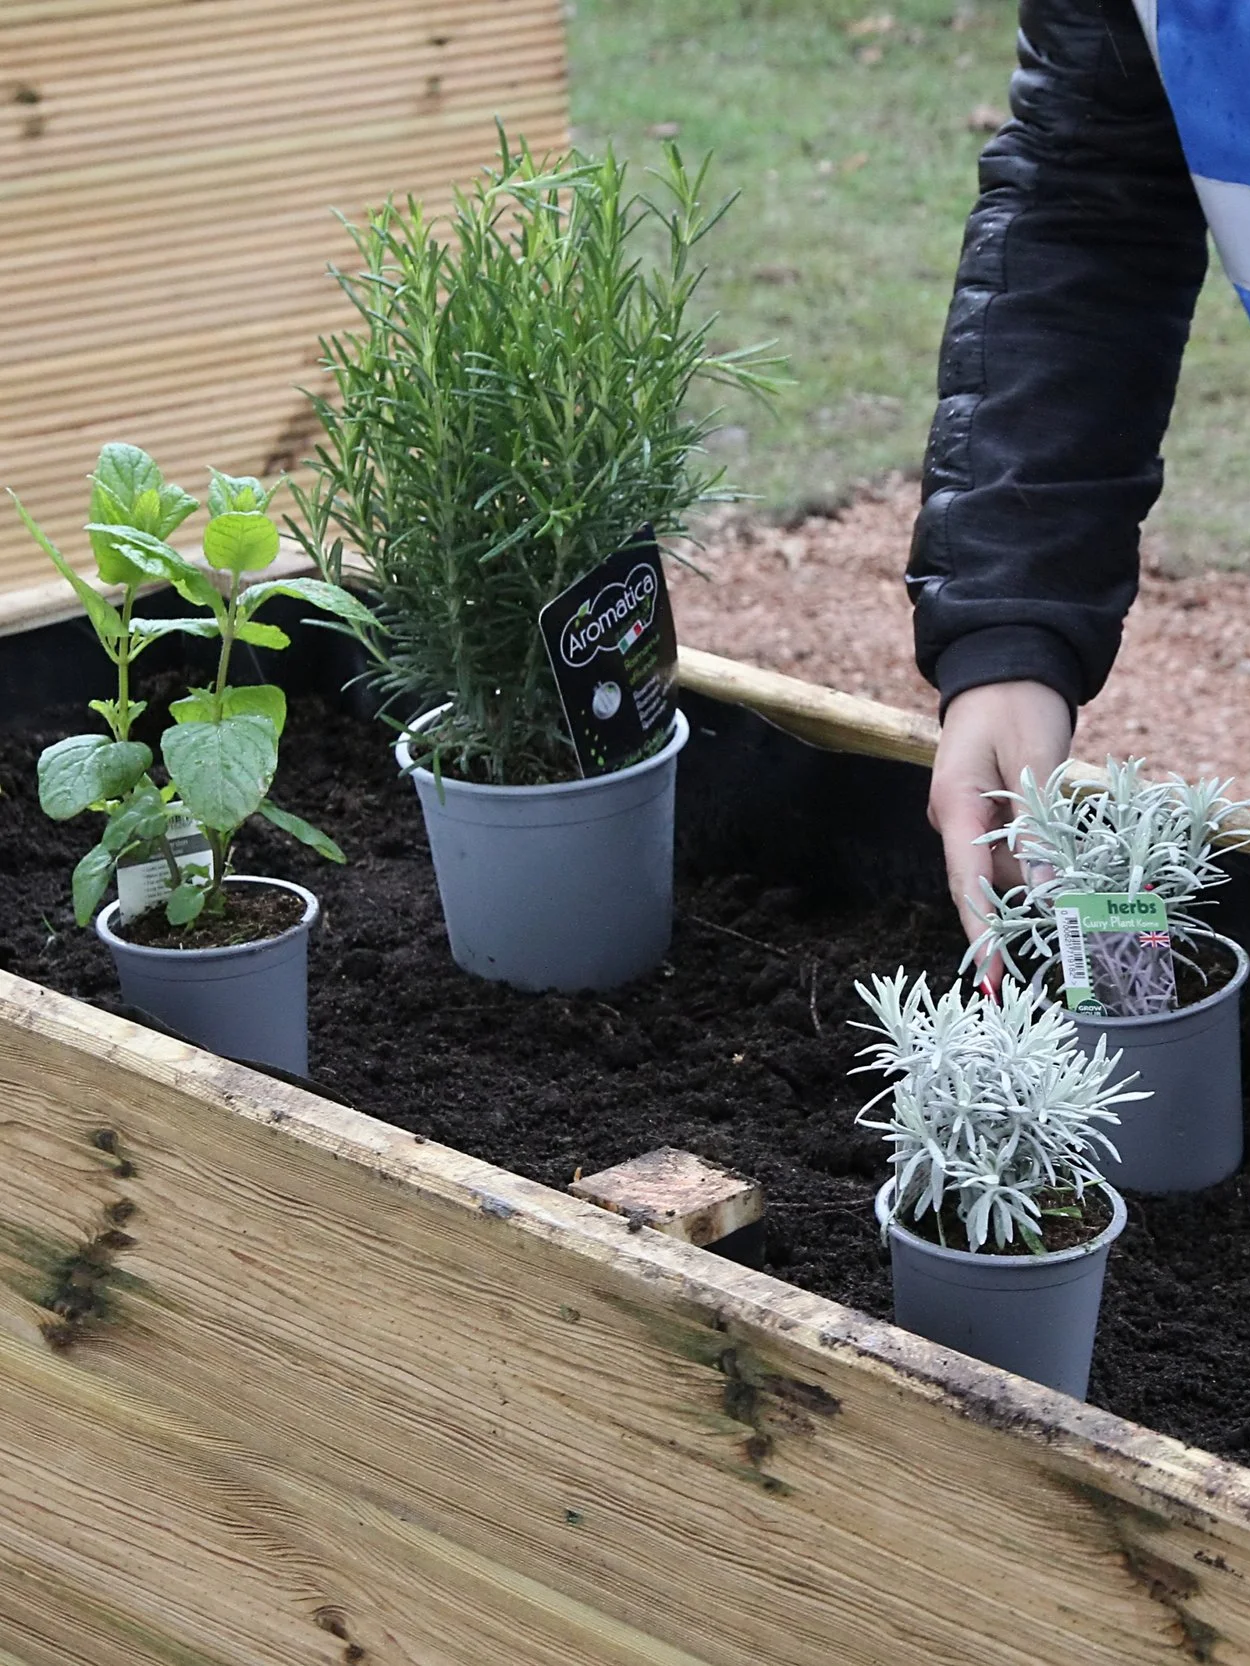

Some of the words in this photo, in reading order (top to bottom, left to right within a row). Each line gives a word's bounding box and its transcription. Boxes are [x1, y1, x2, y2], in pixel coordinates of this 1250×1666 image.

[569, 574, 655, 659] Aromatica
[1107, 899, 1157, 915] herbs
[1082, 915, 1108, 930] Curry
[1110, 915, 1135, 928] Plant
